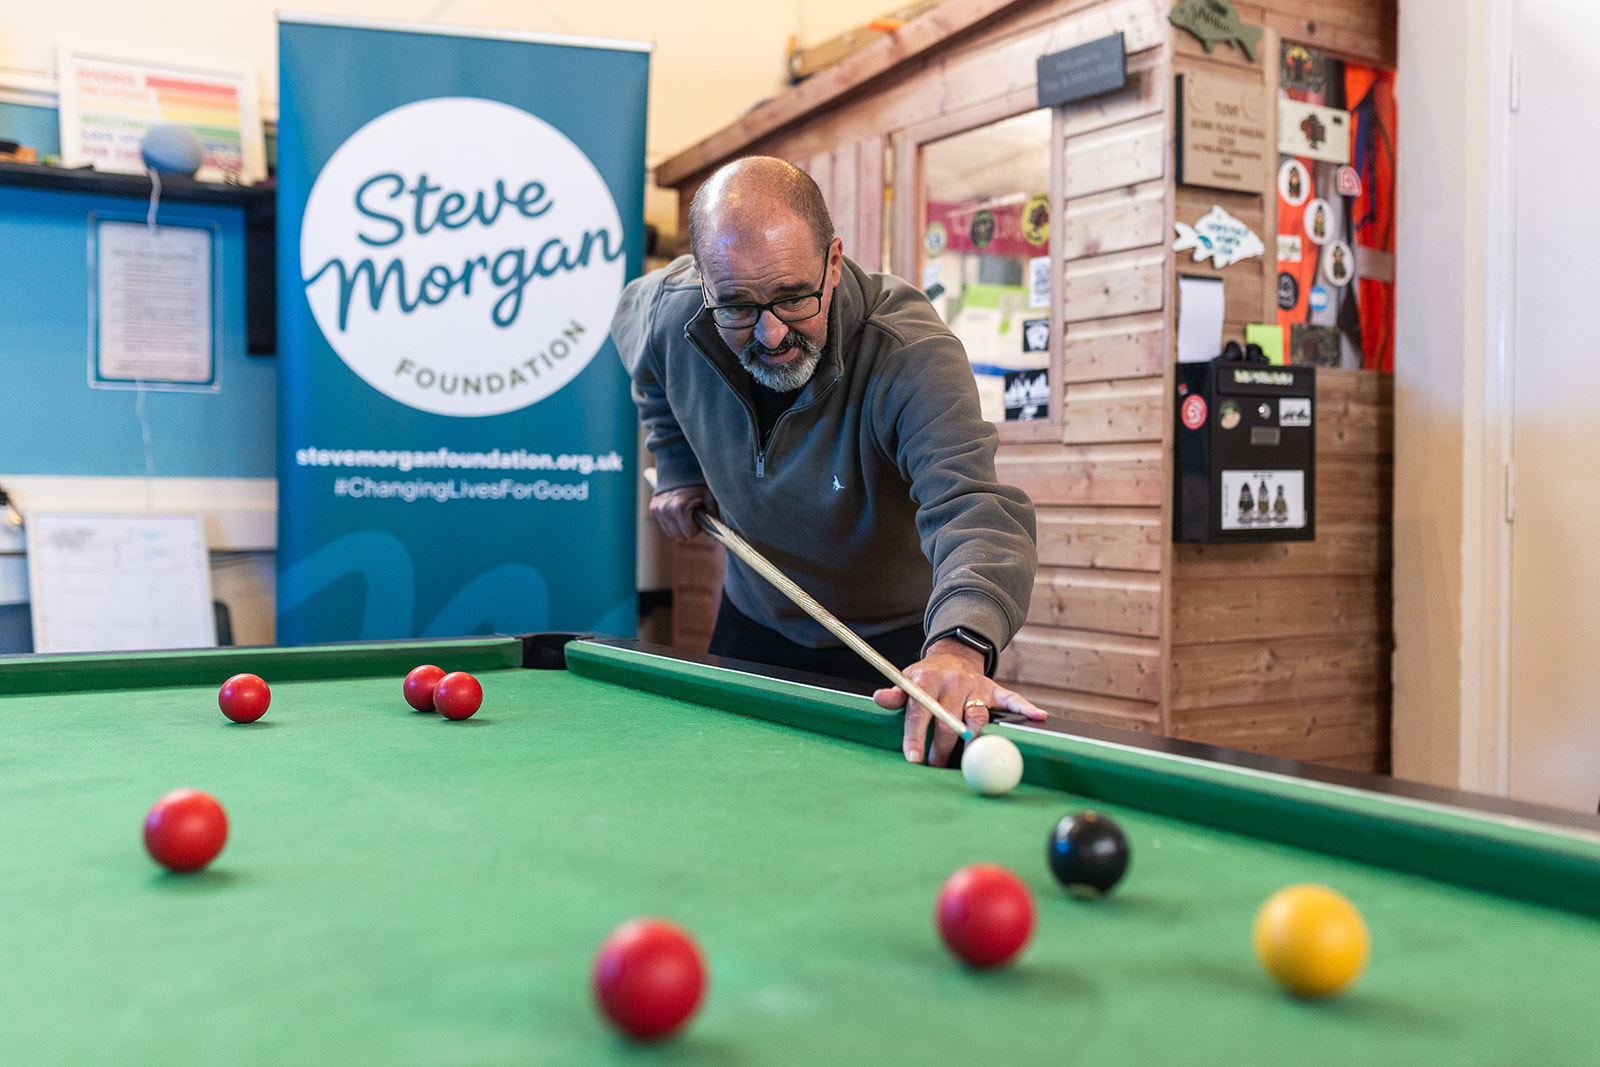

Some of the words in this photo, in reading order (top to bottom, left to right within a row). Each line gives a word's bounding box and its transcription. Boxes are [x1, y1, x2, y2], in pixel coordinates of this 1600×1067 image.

[355, 173, 554, 247] Steve
[303, 229, 626, 332] Morgan
[395, 319, 587, 396] FOUNDATION
[296, 446, 623, 475] stevemorganfoundation.org.uk
[334, 476, 589, 502] #ChangingLivesForGood
